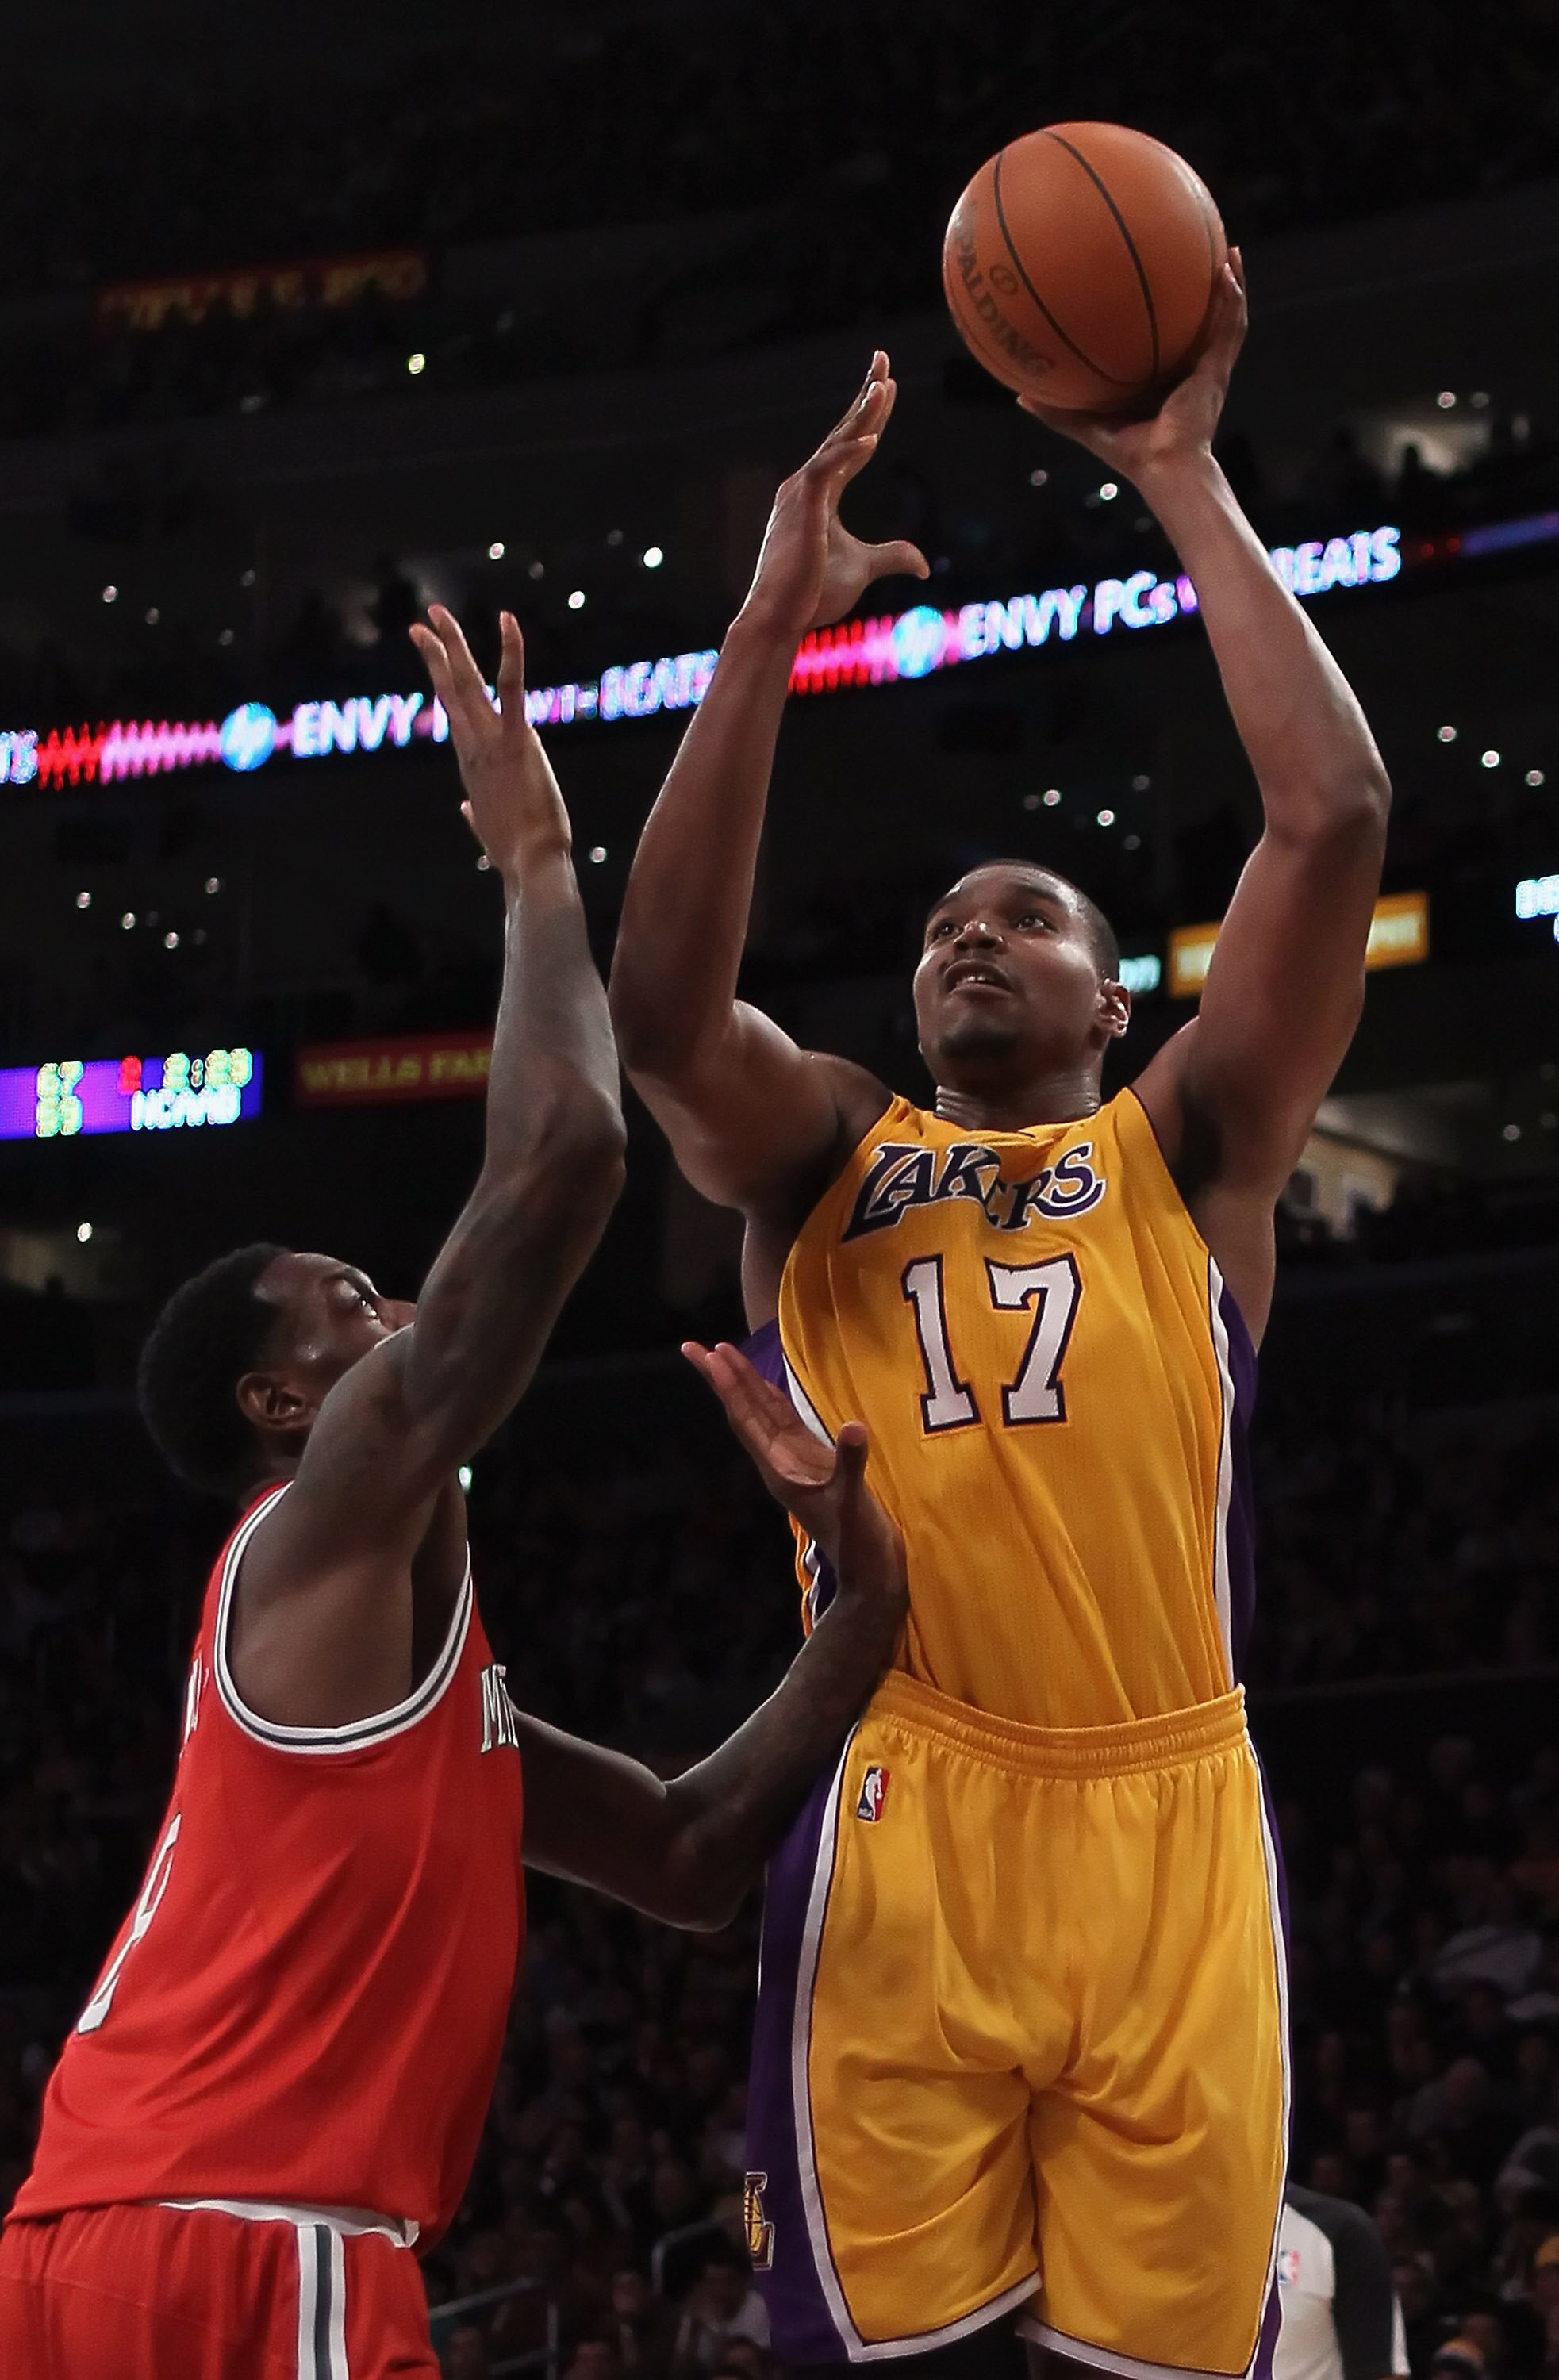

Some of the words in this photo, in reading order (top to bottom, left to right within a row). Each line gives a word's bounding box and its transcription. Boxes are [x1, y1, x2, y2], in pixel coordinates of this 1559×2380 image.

[955, 216, 1058, 378] PALDING
[958, 585, 1088, 660] ENVY
[1092, 570, 1177, 635] PCs
[291, 692, 424, 758] ENVY
[900, 1251, 1084, 1434] 17
